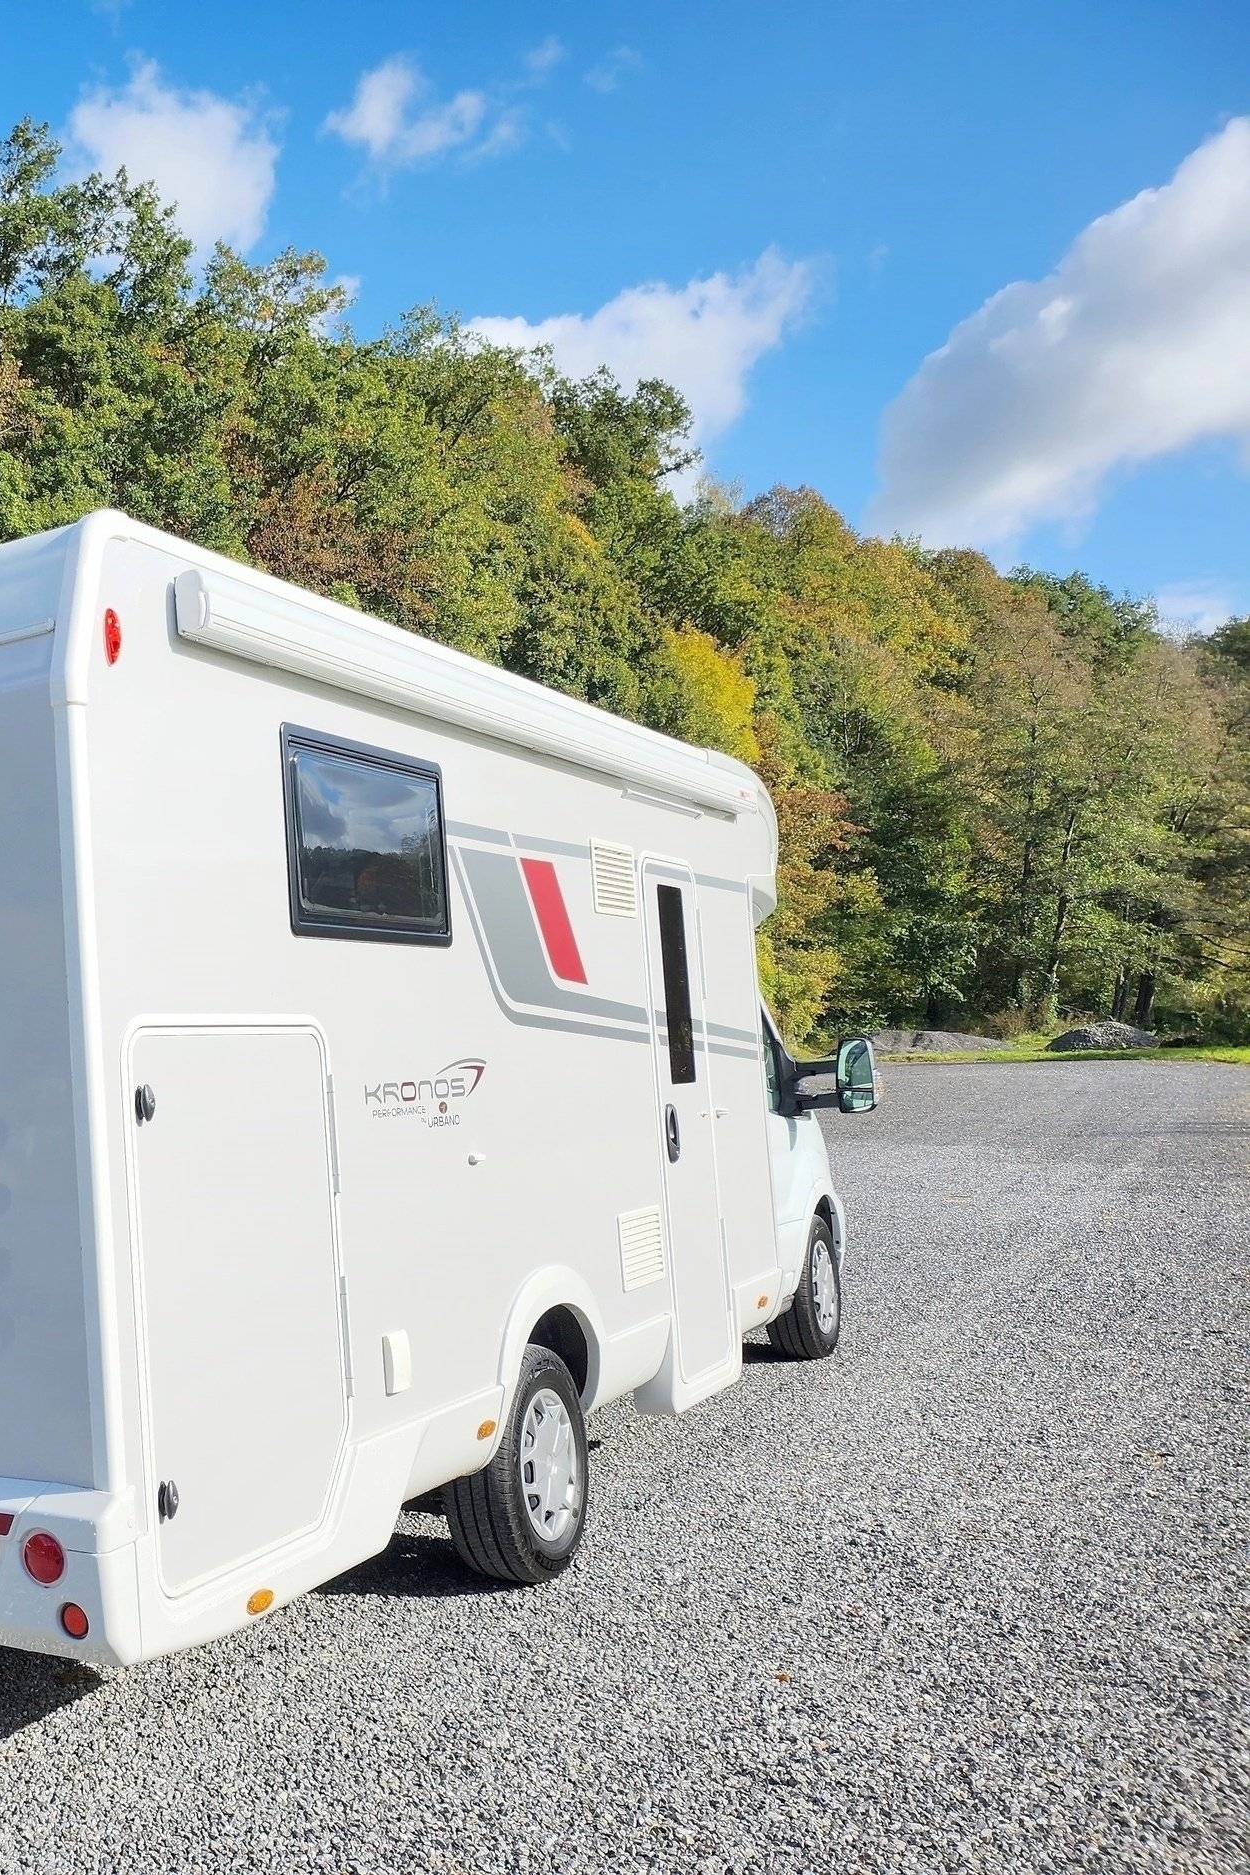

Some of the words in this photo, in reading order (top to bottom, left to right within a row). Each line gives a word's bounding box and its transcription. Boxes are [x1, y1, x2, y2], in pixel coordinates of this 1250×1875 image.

[364, 1077, 466, 1105] KRONOS
[372, 1105, 427, 1118] PERFORMANCE
[428, 1114, 461, 1128] URBANO
